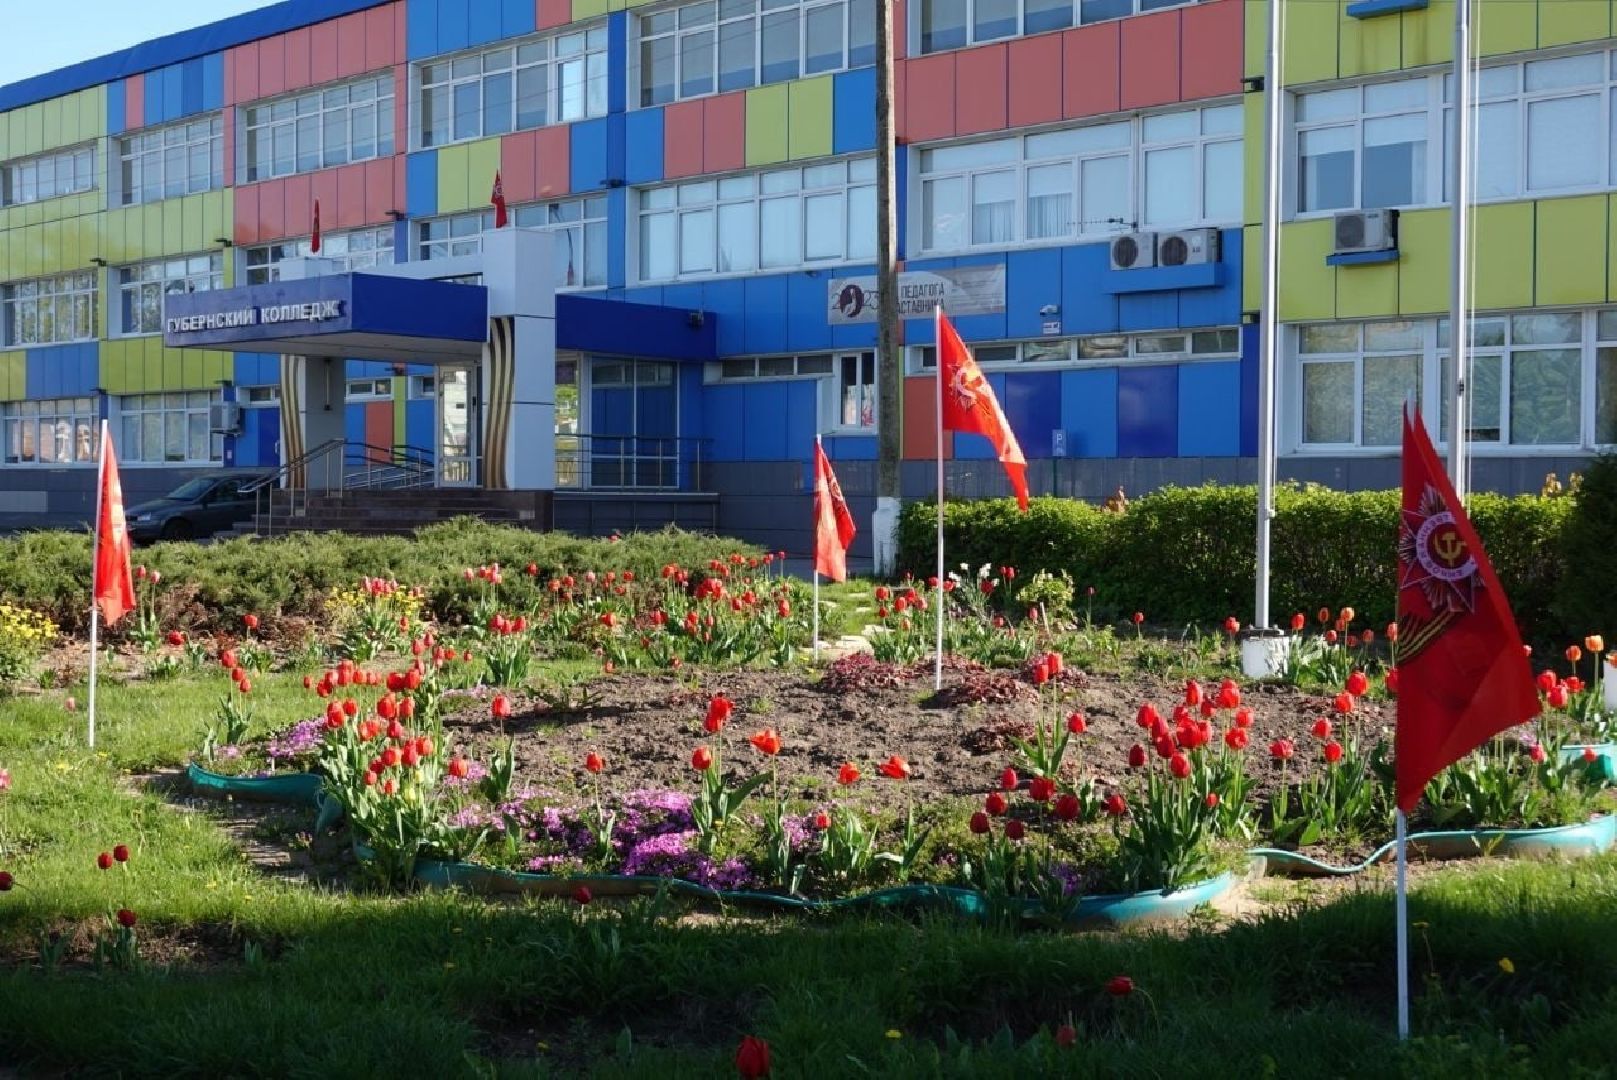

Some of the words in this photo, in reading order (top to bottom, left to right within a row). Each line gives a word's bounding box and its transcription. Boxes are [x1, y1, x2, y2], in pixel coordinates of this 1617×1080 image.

[900, 282, 945, 299] ПЕДАГОГА
[167, 306, 256, 333] ГУБЕРНСКИЙ
[261, 300, 341, 324] КОЛЛЕДЖ
